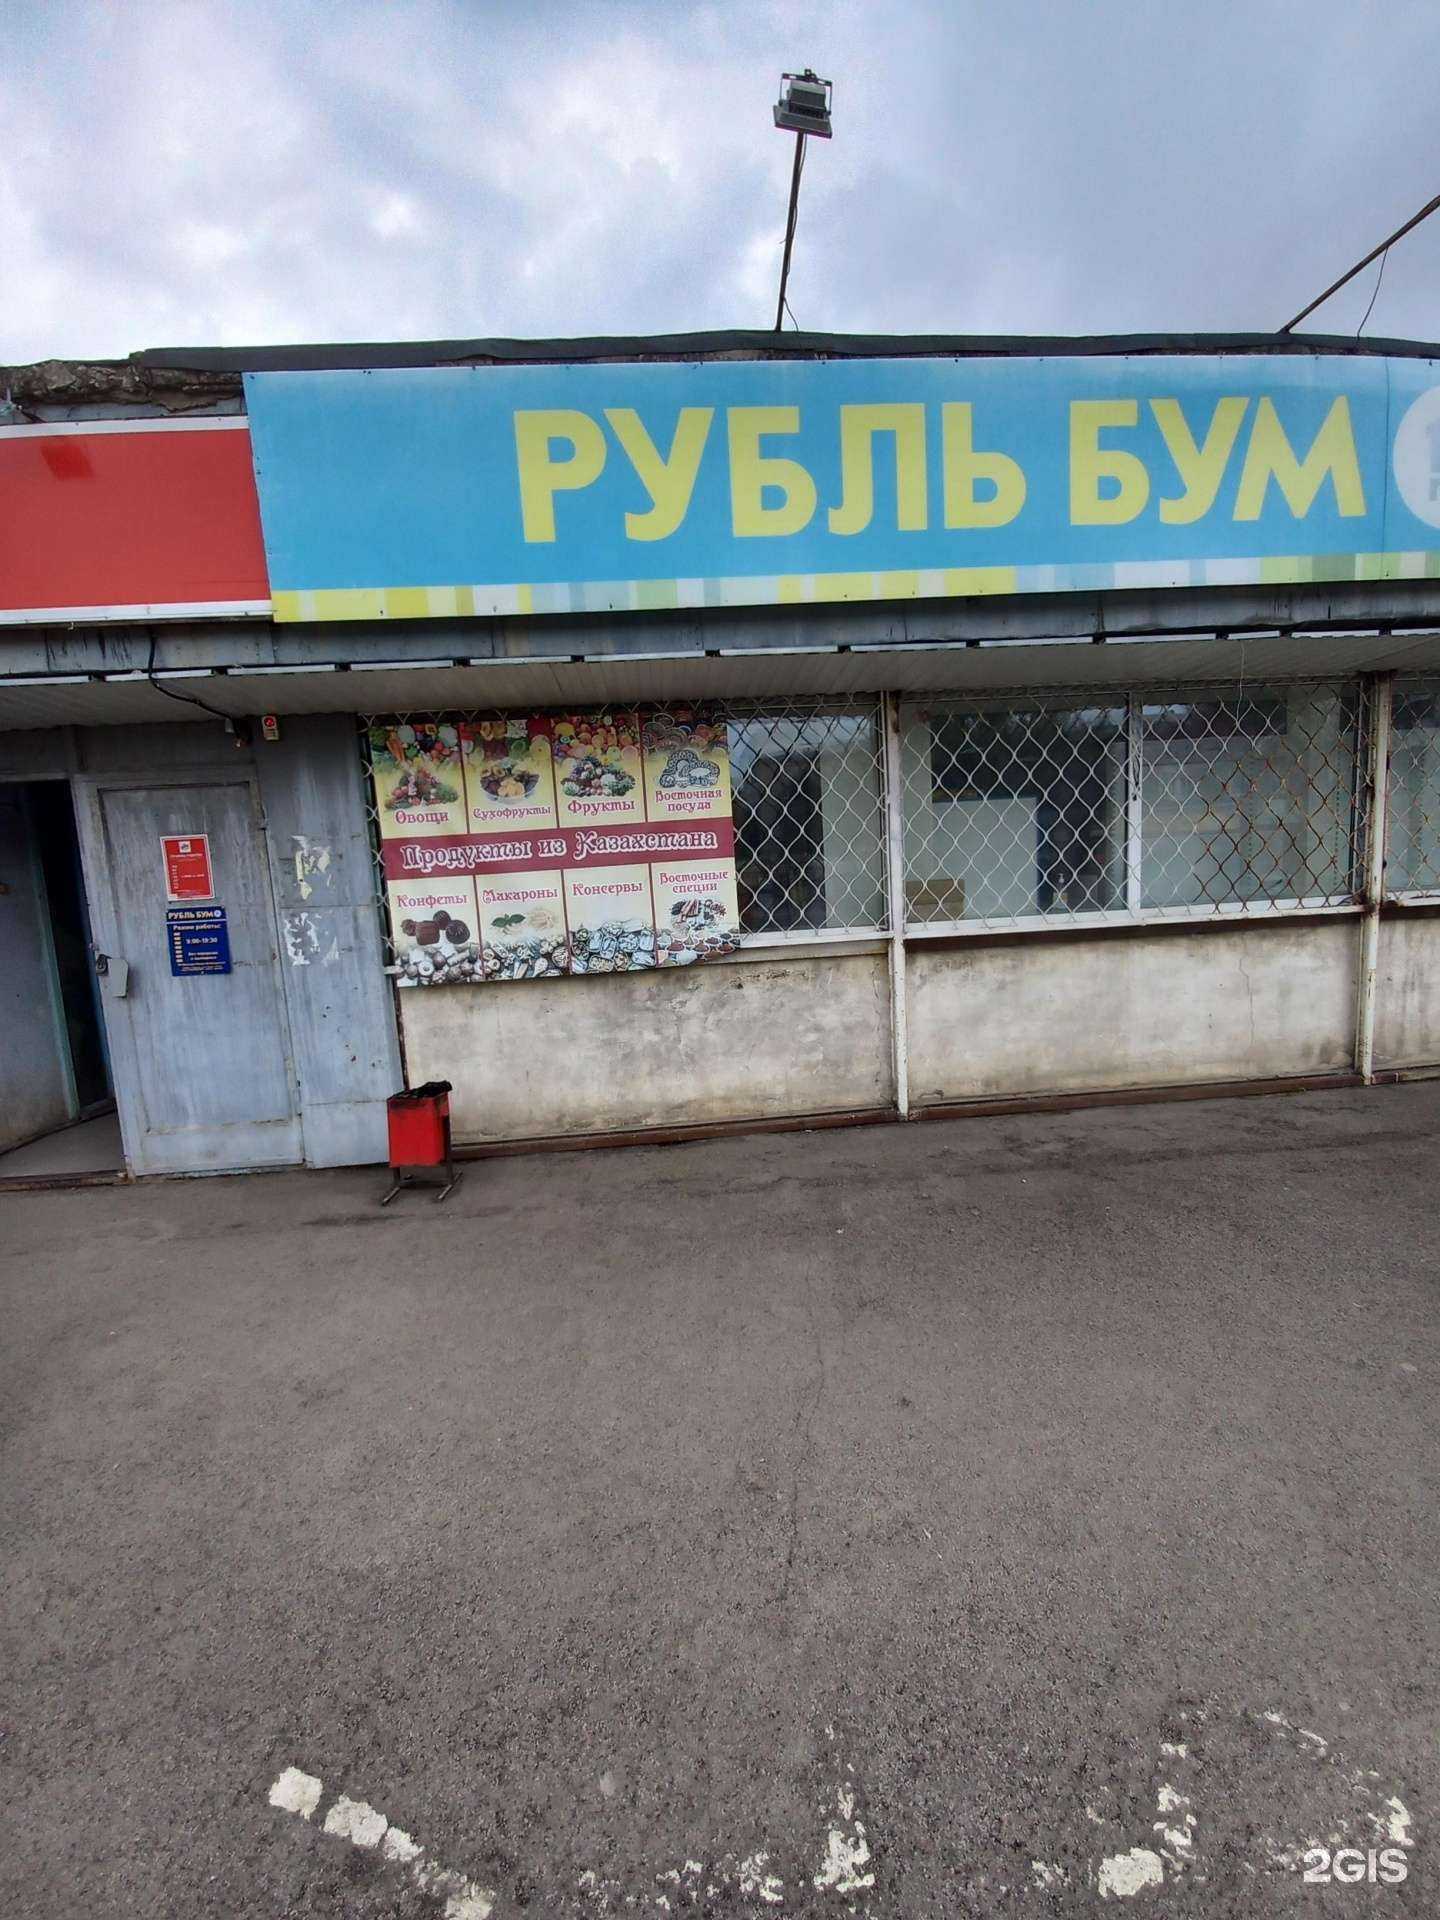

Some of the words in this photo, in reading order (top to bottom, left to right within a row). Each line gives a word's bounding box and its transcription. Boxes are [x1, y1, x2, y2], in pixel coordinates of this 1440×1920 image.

[514, 402, 1028, 543] РУБЛЬ
[1068, 396, 1365, 526] БУМ
[655, 788, 722, 801] Восточная
[473, 804, 551, 823] Сухофрукты
[567, 799, 635, 816] Фрукты
[667, 800, 711, 814] посуда
[395, 808, 449, 824] Овощи
[401, 841, 531, 871] Продукты
[538, 838, 566, 858] из
[573, 831, 717, 859] Казахстана
[659, 870, 729, 885] Восточные
[482, 887, 558, 903] Макароны
[572, 881, 643, 896] Консервы
[672, 882, 718, 894] специи
[396, 893, 469, 908] Конфеты
[168, 911, 195, 920] РУБЛЬ
[196, 910, 214, 919] БУМ
